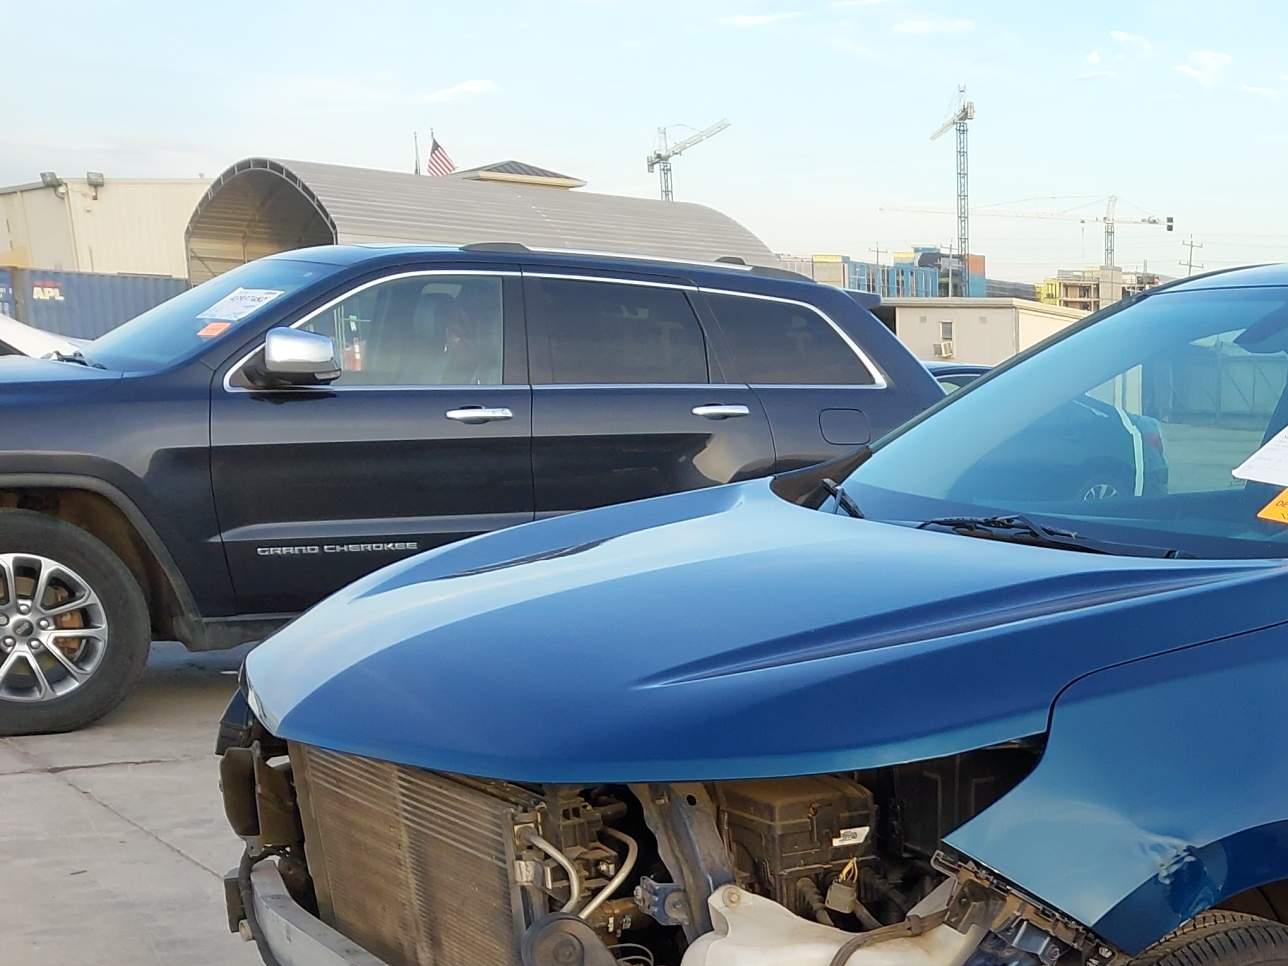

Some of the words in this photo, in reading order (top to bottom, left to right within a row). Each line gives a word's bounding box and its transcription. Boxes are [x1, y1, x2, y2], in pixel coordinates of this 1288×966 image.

[33, 286, 64, 299] APL
[257, 546, 319, 555] GRAND
[324, 542, 418, 552] CHEROKEE
